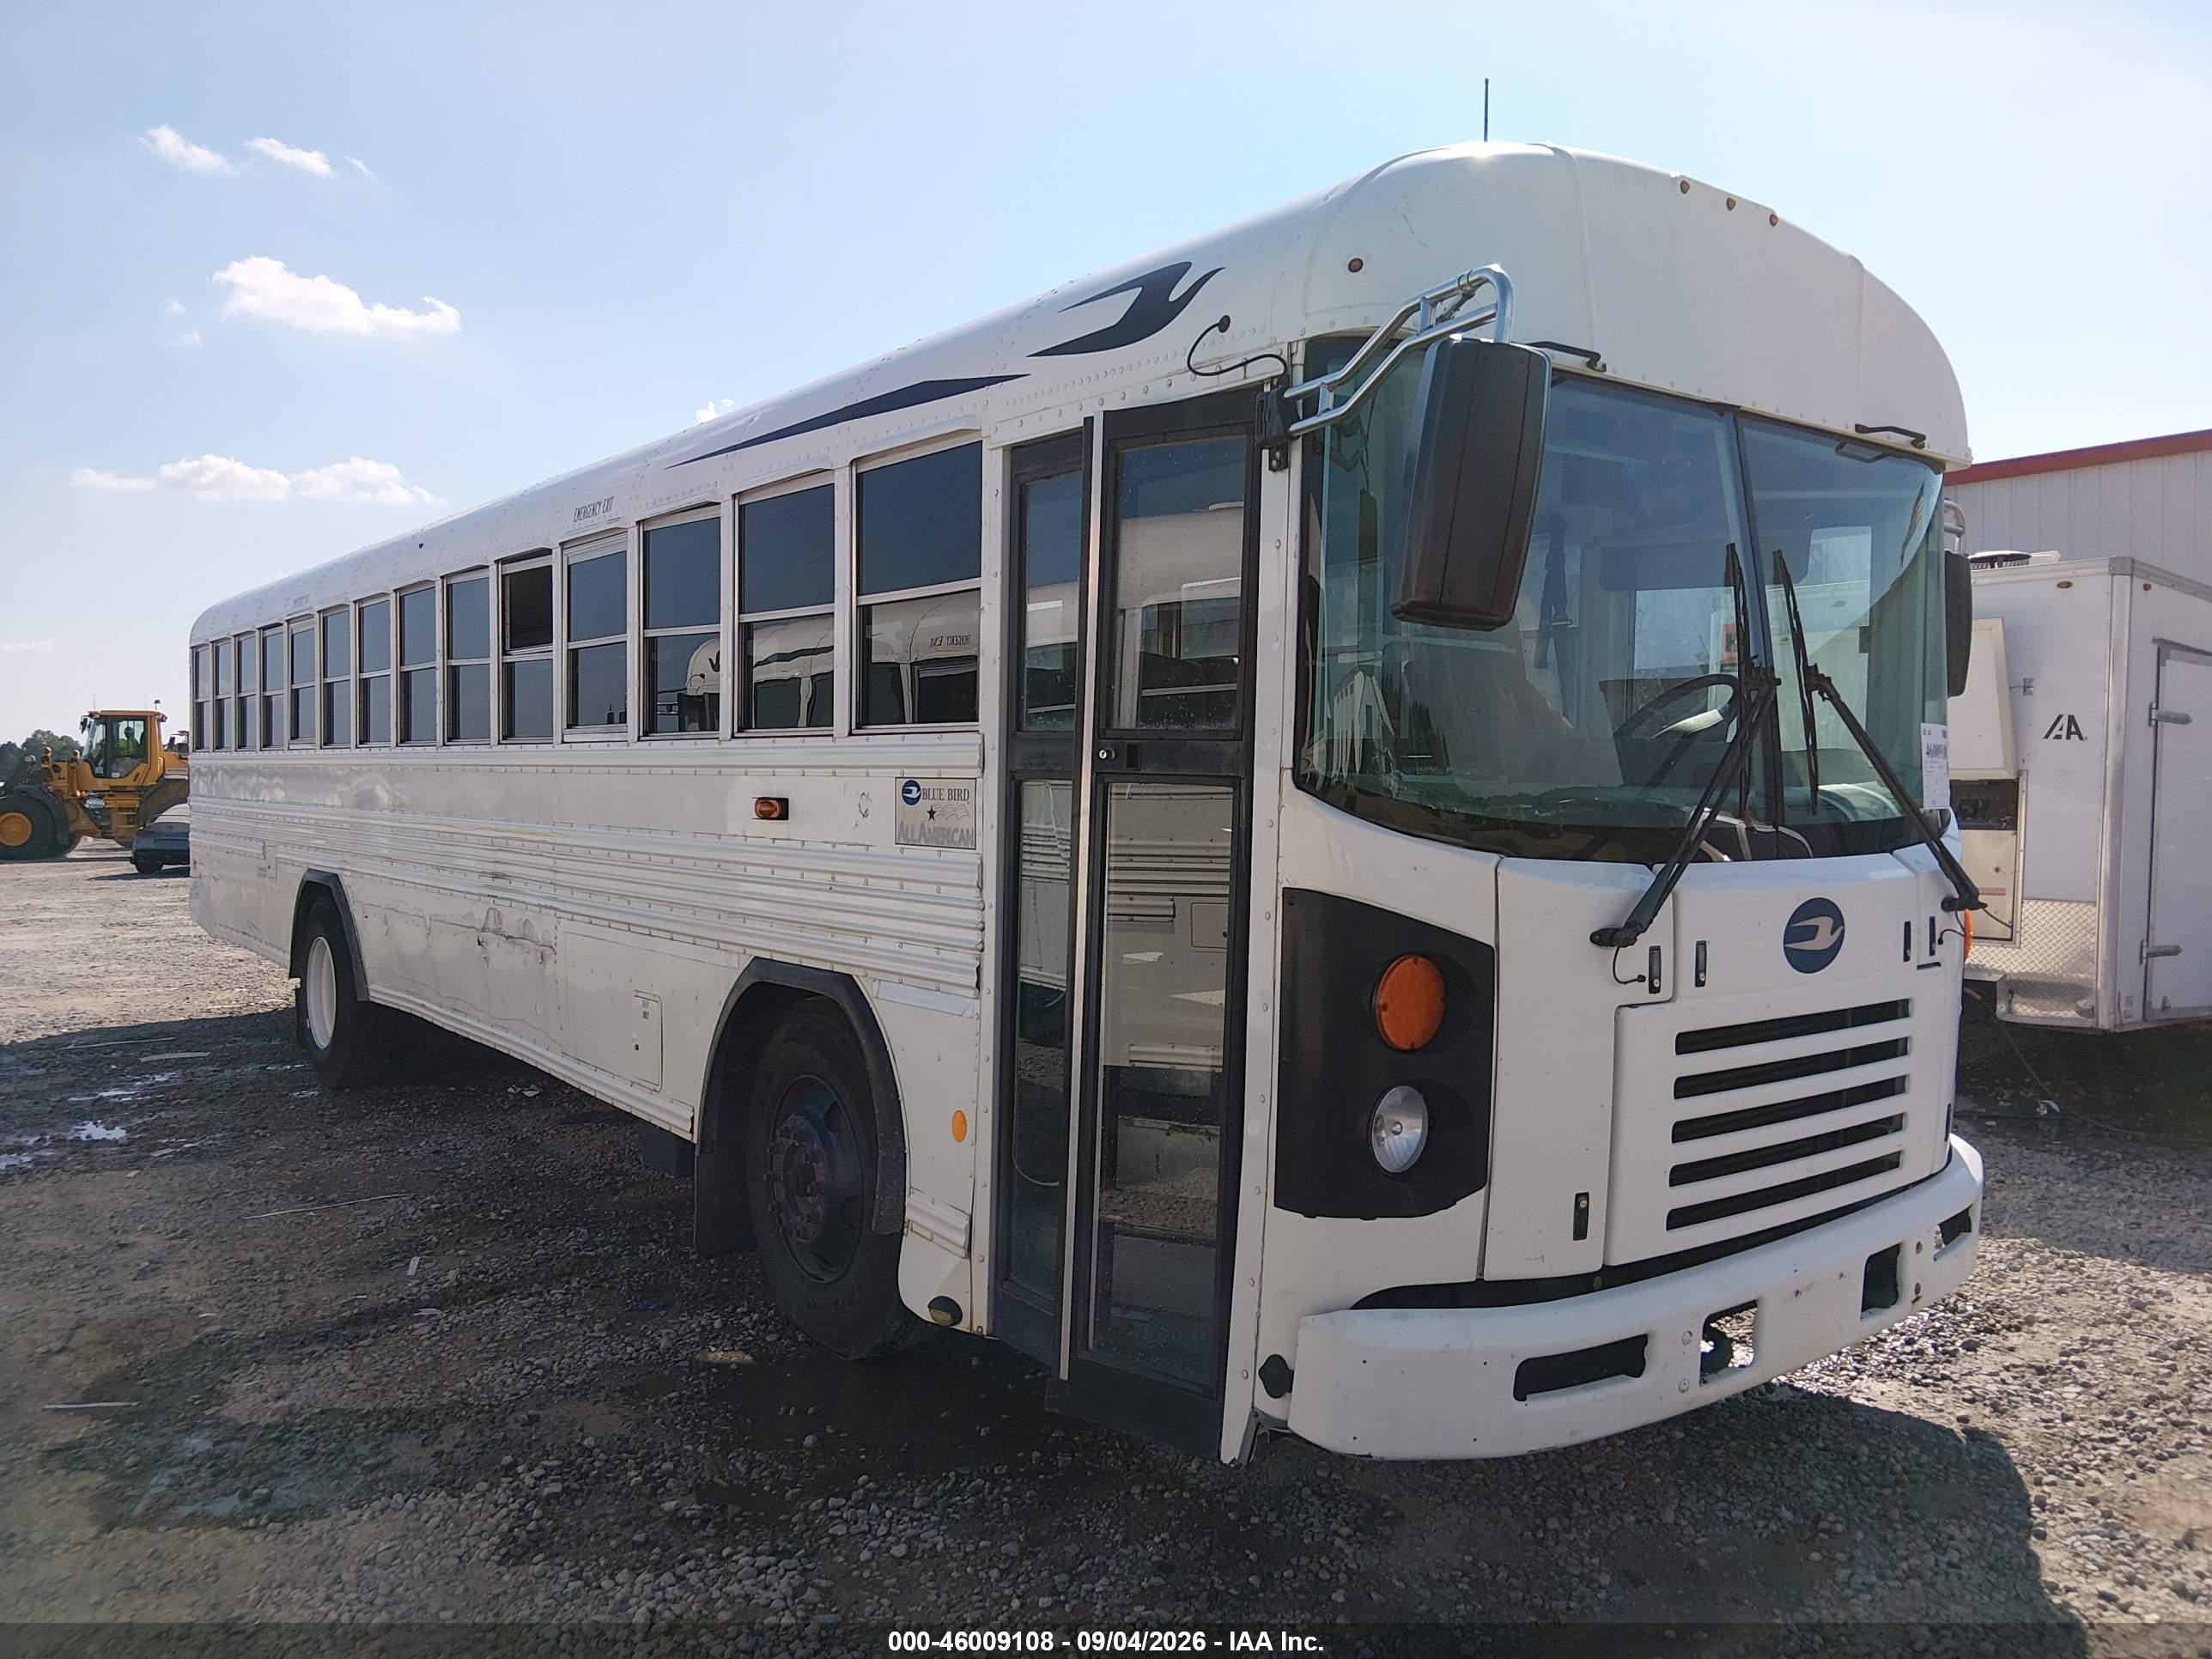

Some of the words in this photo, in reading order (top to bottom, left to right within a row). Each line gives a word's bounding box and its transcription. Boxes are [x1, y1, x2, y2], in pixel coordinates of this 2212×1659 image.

[574, 501, 602, 523] EMERGENCY
[602, 495, 615, 514] EXIT
[922, 787, 945, 801] BLUE
[947, 788, 969, 802] BIRD
